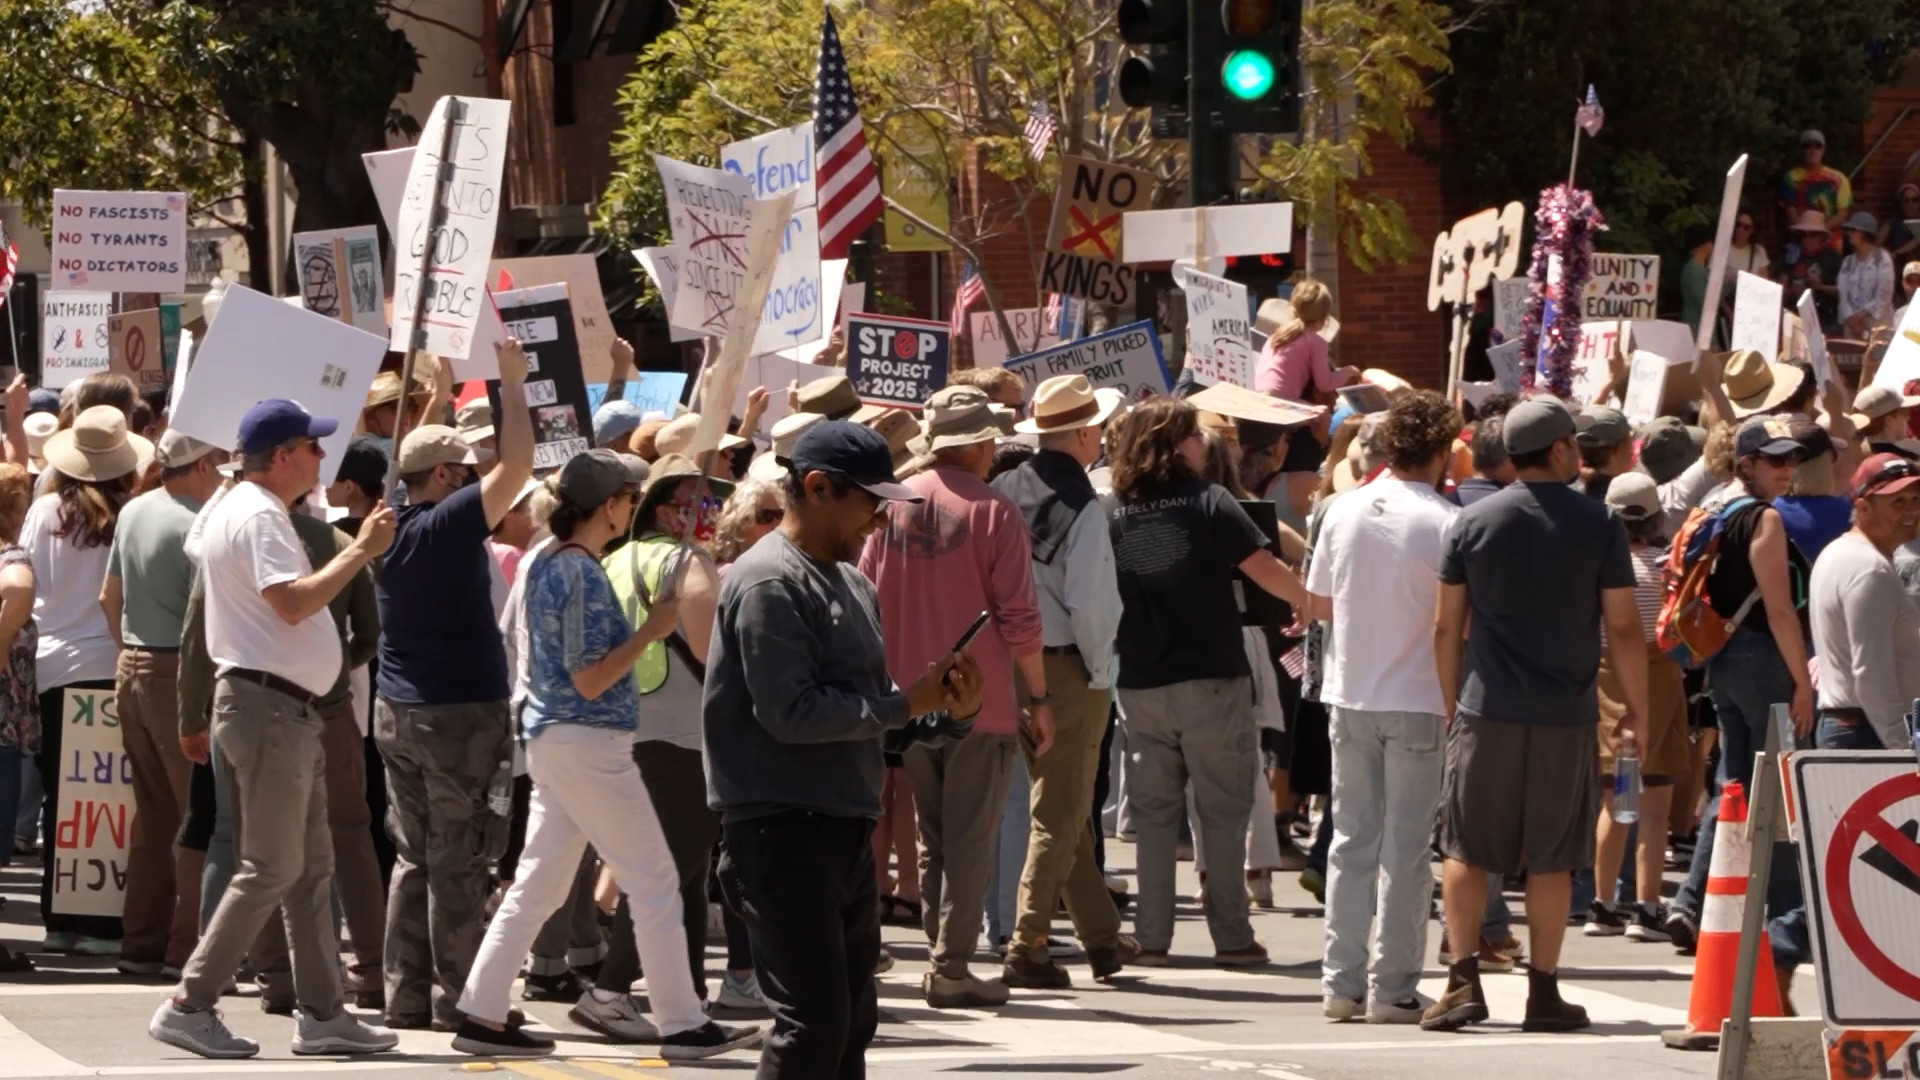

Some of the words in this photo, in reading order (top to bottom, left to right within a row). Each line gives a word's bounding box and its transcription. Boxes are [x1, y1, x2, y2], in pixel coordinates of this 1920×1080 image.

[1072, 164, 1137, 208] NO
[60, 205, 82, 217] NO
[89, 206, 169, 220] FASCISTS
[59, 232, 82, 244] NO
[91, 232, 168, 247] TYRANTS
[59, 259, 82, 271] NO
[87, 259, 178, 274] DICTATORS
[1594, 258, 1653, 279] UNITY
[1041, 251, 1131, 305] KINGS
[1605, 282, 1640, 296] AND
[1587, 298, 1655, 318] EQUALITY
[74, 328, 83, 348] &
[1212, 318, 1250, 342] AMERICA
[859, 327, 938, 361] STOP
[1046, 344, 1097, 374] FAMILY
[1103, 331, 1148, 353] PICKED
[860, 358, 932, 379] PROJECT
[1083, 359, 1124, 385] FRUIT
[529, 382, 555, 403] NEW
[871, 377, 917, 399] 2025
[1160, 496, 1187, 508] DAN
